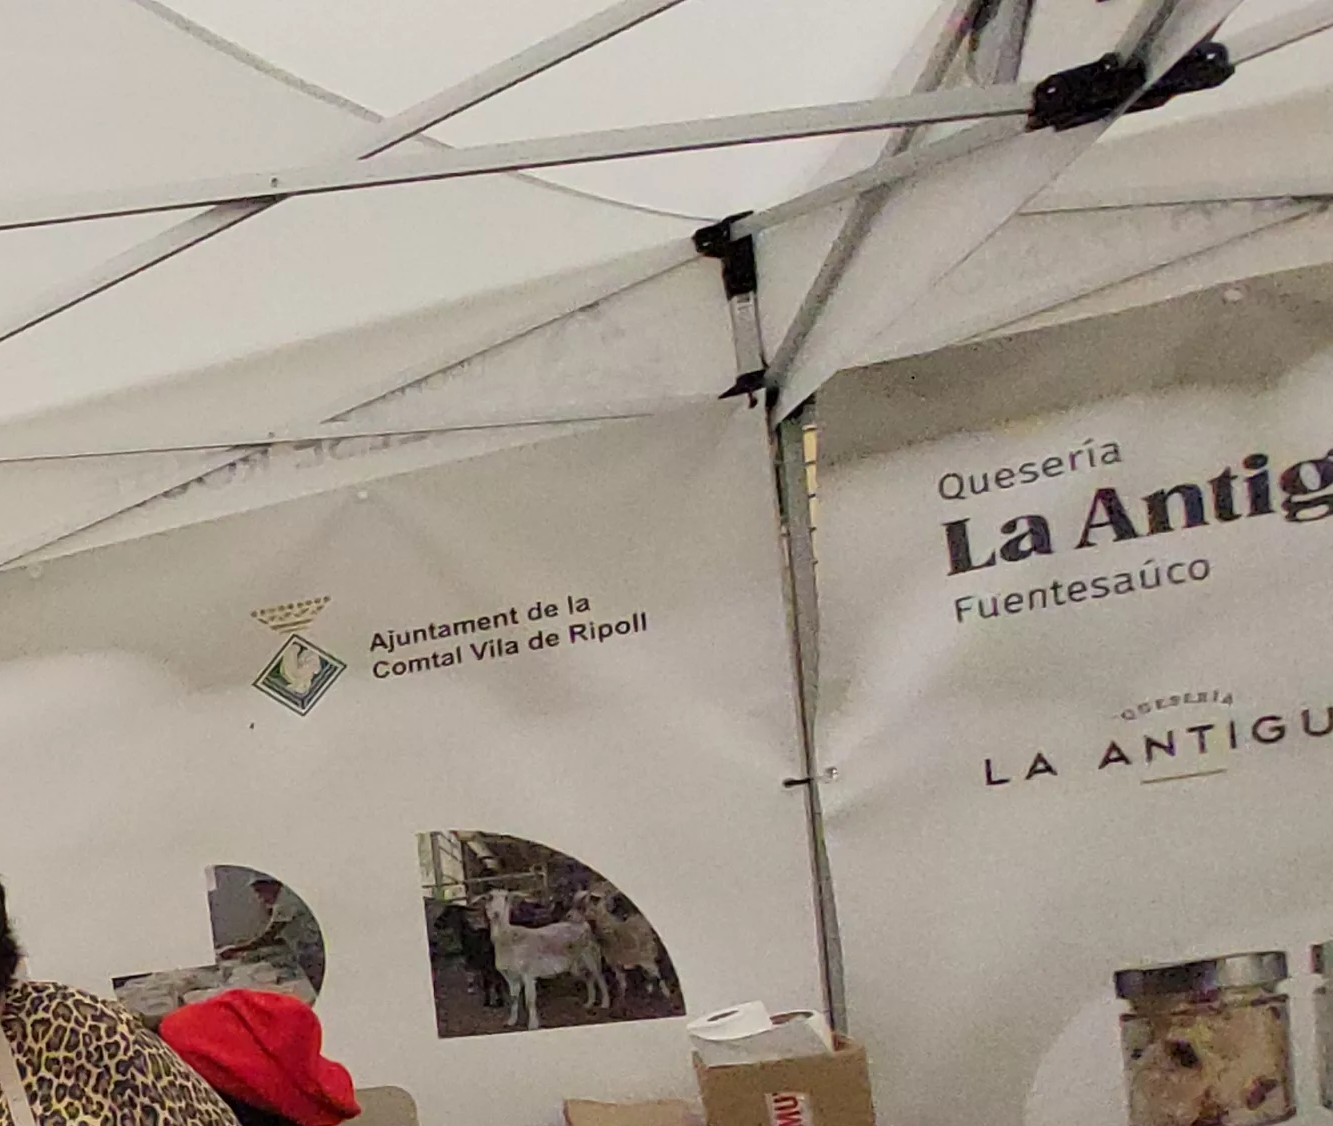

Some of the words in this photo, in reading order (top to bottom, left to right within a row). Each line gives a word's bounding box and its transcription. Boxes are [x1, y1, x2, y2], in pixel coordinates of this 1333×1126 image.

[938, 438, 1123, 500] Quesería
[941, 513, 1054, 577] La
[1074, 449, 1333, 550] Antig
[954, 558, 1212, 623] Fuentesaúco
[369, 607, 519, 653] Ajuntament
[527, 601, 559, 622] de
[567, 595, 591, 615] la
[372, 646, 462, 679] Comtal
[470, 638, 519, 661] Vila
[528, 629, 560, 649] de
[569, 612, 647, 644] Ripoll
[984, 752, 1058, 787] LA
[1098, 706, 1333, 770] ANTIGU
